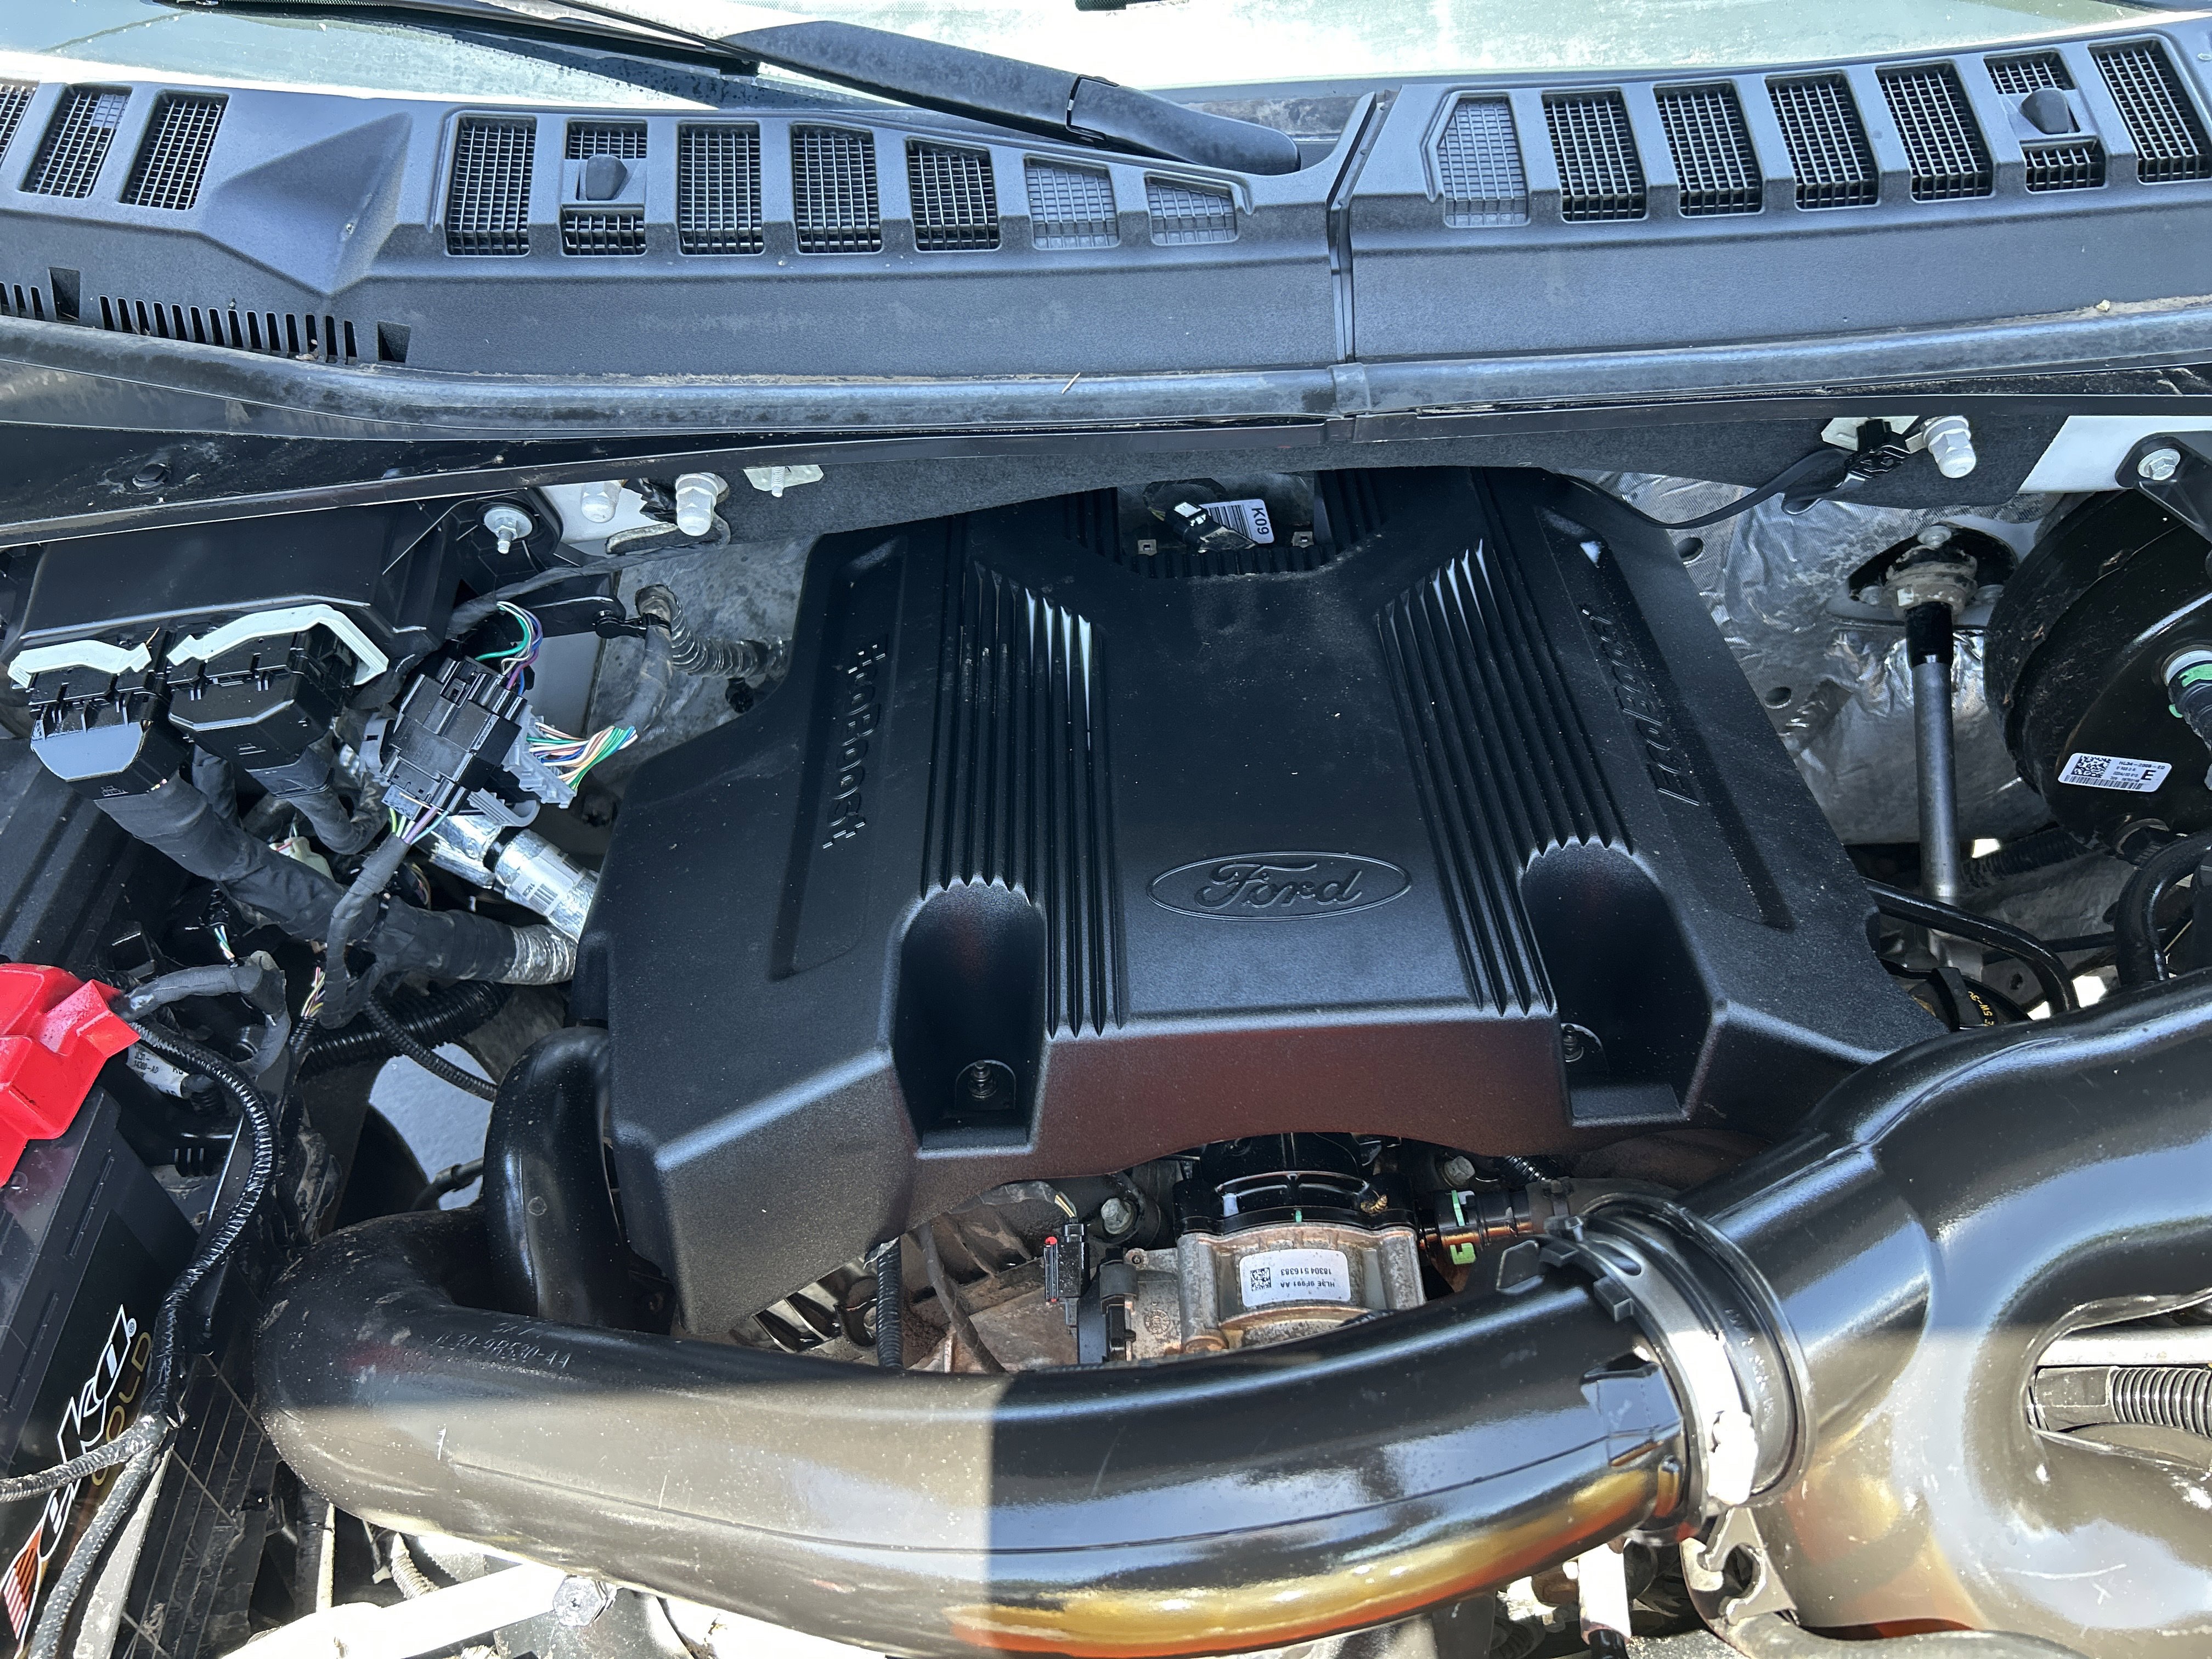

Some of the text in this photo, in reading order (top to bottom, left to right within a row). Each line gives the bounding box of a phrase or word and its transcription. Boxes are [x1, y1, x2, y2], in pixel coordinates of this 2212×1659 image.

[1251, 507, 1269, 535] K09
[2141, 769, 2157, 781] E
[1193, 862, 1363, 910] Ford
[0, 1304, 132, 1659] Deka
